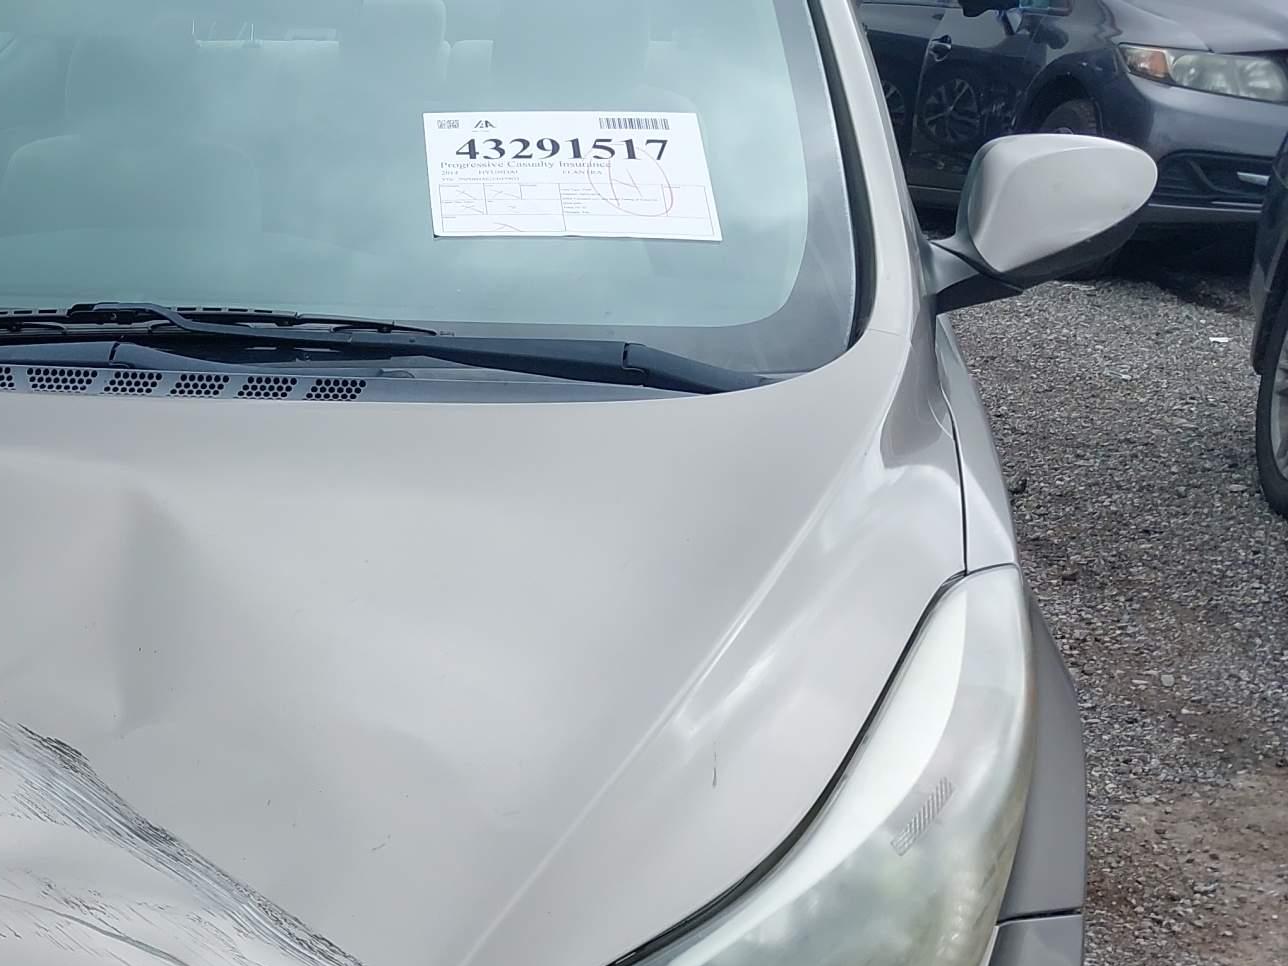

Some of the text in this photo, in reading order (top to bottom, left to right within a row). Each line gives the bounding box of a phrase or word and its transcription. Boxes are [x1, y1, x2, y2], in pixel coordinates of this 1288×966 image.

[455, 137, 668, 161] 43291517
[440, 160, 612, 170] Progressive Casualty Insurance
